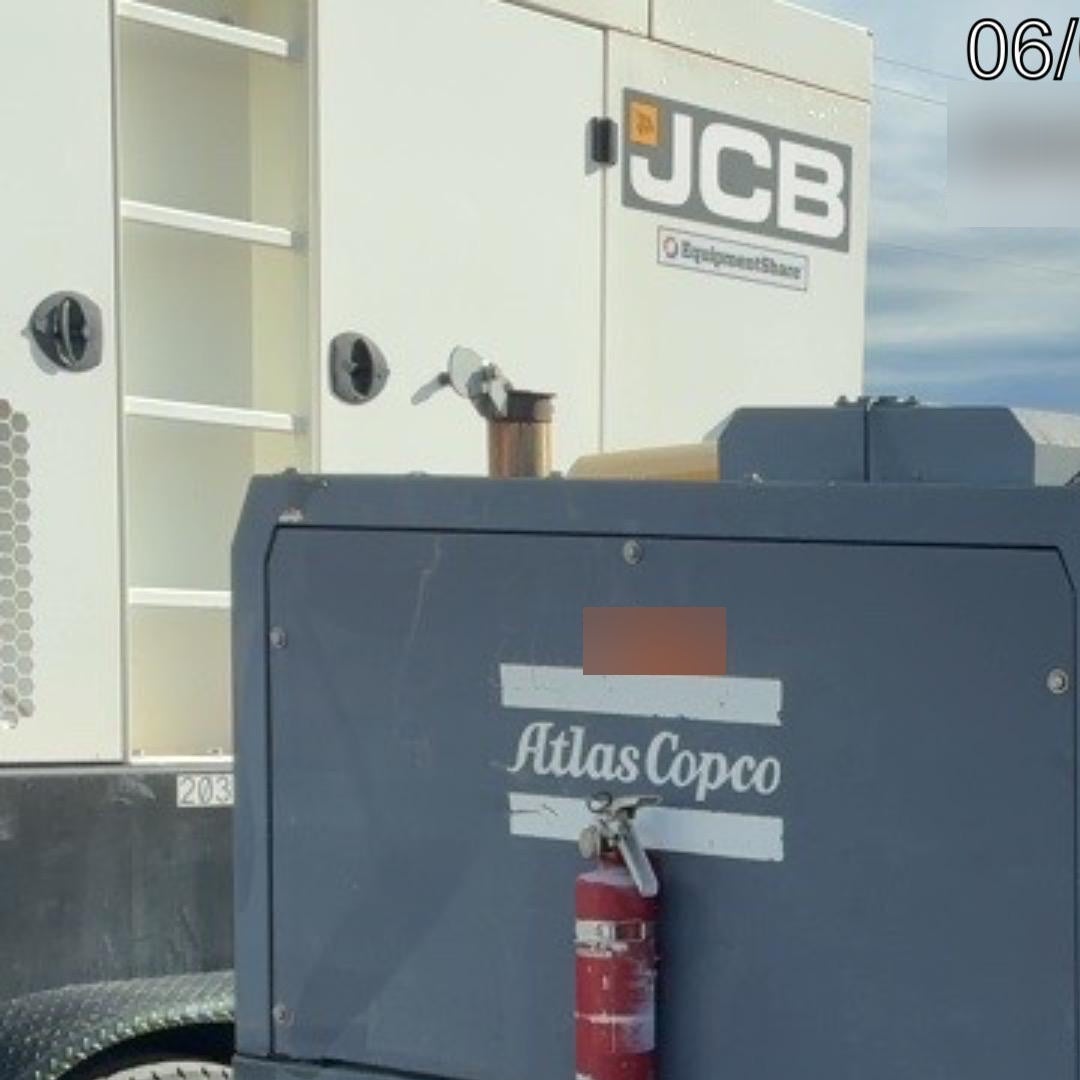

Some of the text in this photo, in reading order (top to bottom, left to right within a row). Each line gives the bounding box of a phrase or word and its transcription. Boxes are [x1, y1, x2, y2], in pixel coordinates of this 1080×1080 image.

[628, 112, 847, 239] JCB
[680, 240, 802, 280] EquipmentShare
[507, 721, 781, 802] Atlas Copco
